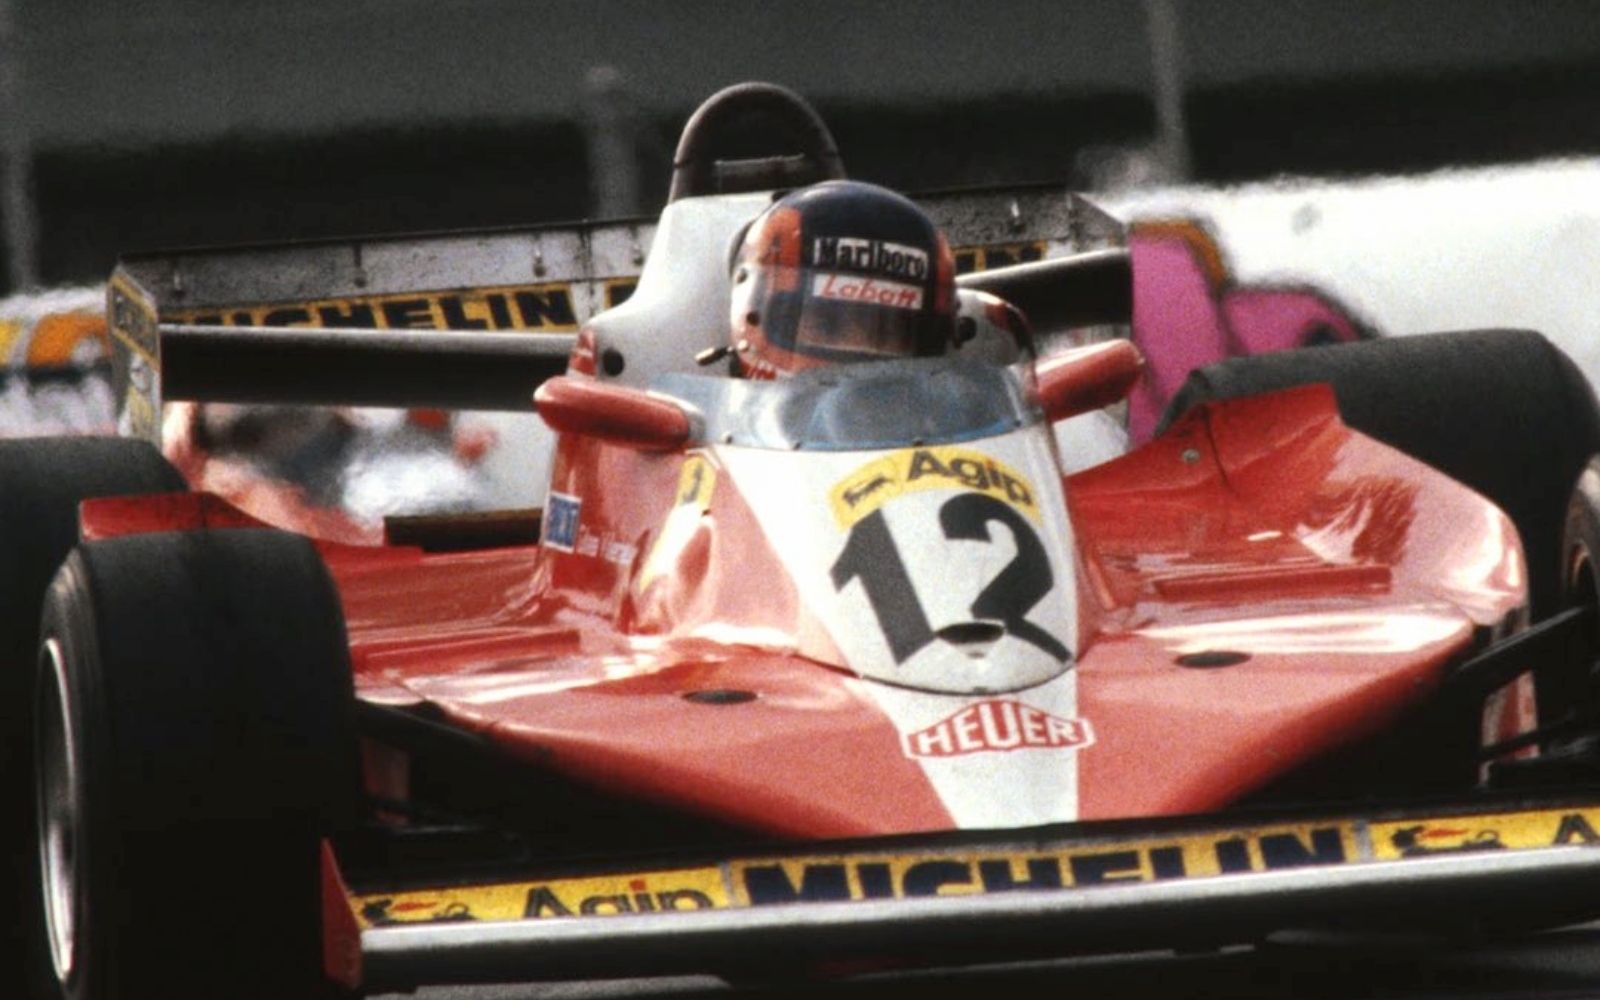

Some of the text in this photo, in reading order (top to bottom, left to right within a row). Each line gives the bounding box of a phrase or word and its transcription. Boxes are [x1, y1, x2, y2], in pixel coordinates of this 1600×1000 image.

[815, 237, 927, 279] Marlboro
[195, 289, 577, 329] CHELIN
[822, 273, 919, 308] Labatt
[905, 450, 1034, 508] Agip
[829, 492, 1074, 667] 12
[915, 701, 1078, 755] HEUER
